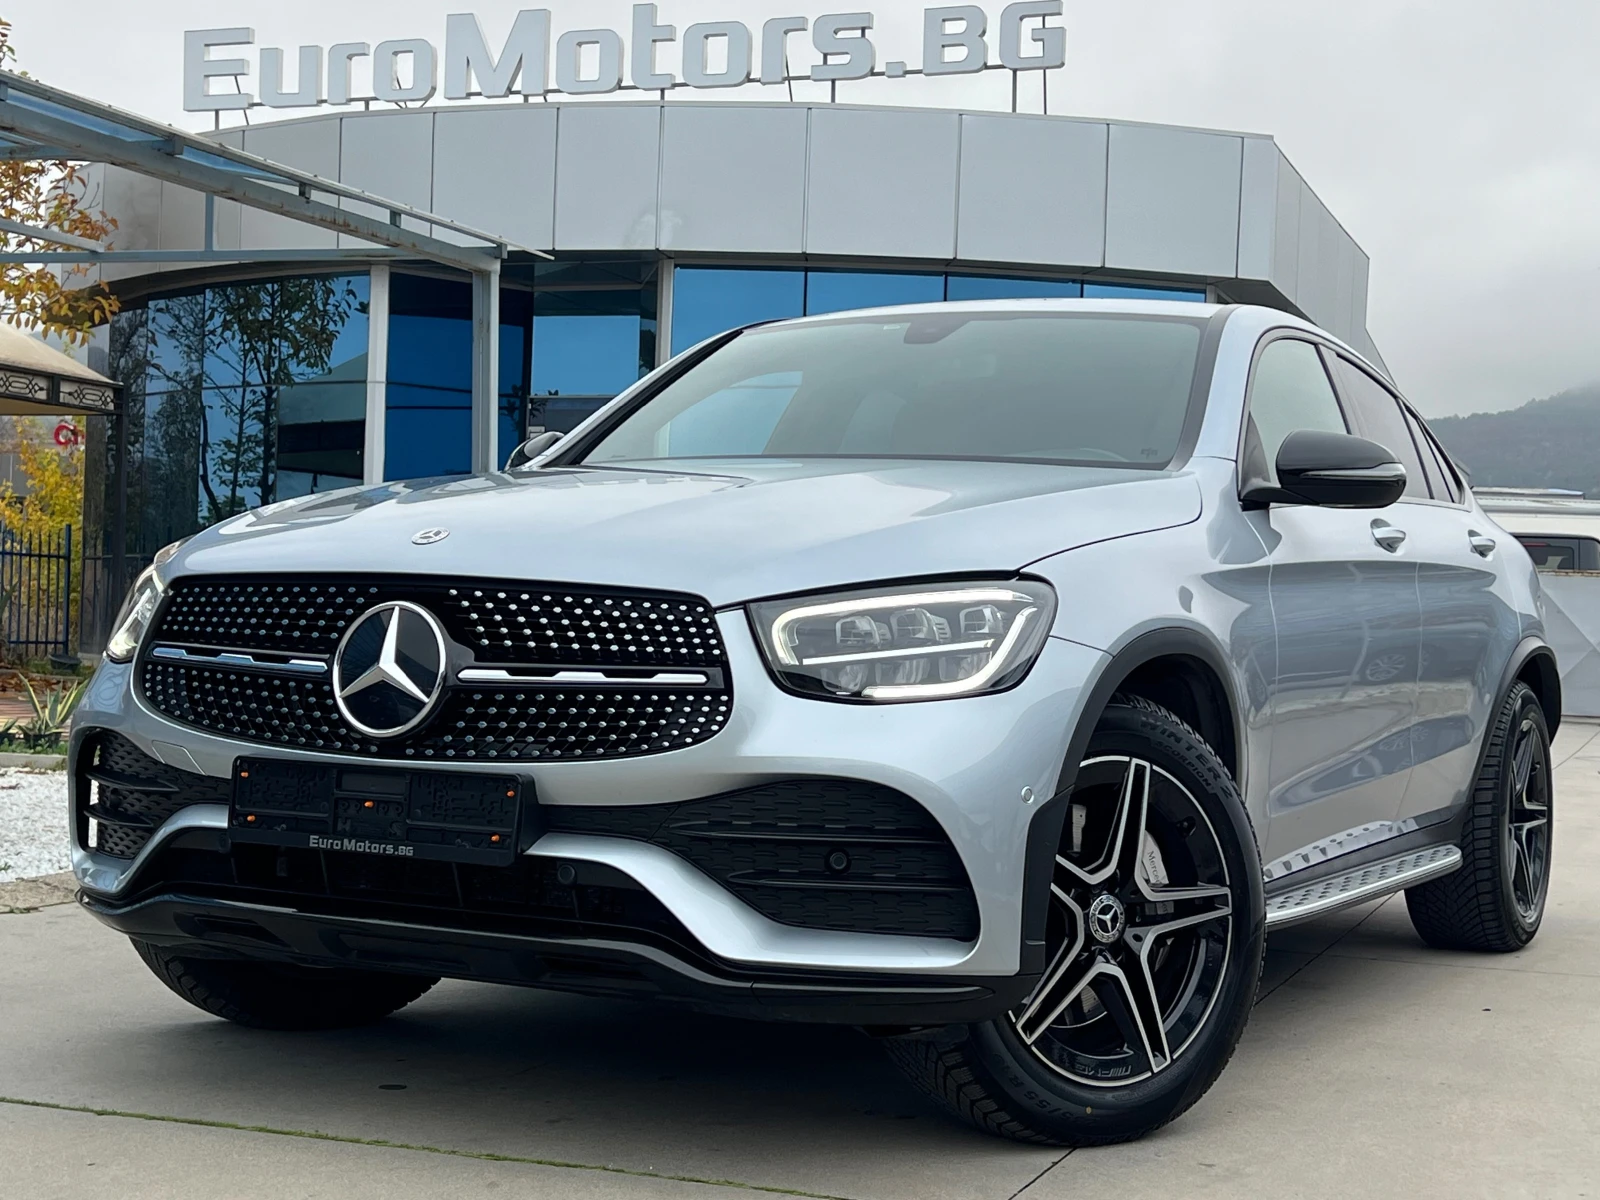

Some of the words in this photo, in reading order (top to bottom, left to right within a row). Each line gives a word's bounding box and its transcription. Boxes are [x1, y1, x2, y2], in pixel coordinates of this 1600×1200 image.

[183, 0, 1066, 112] EuroMotors.BG
[1140, 718, 1221, 781] WINTER
[1154, 741, 1212, 787] SCORPION
[309, 835, 414, 857] EuroMotors.BG
